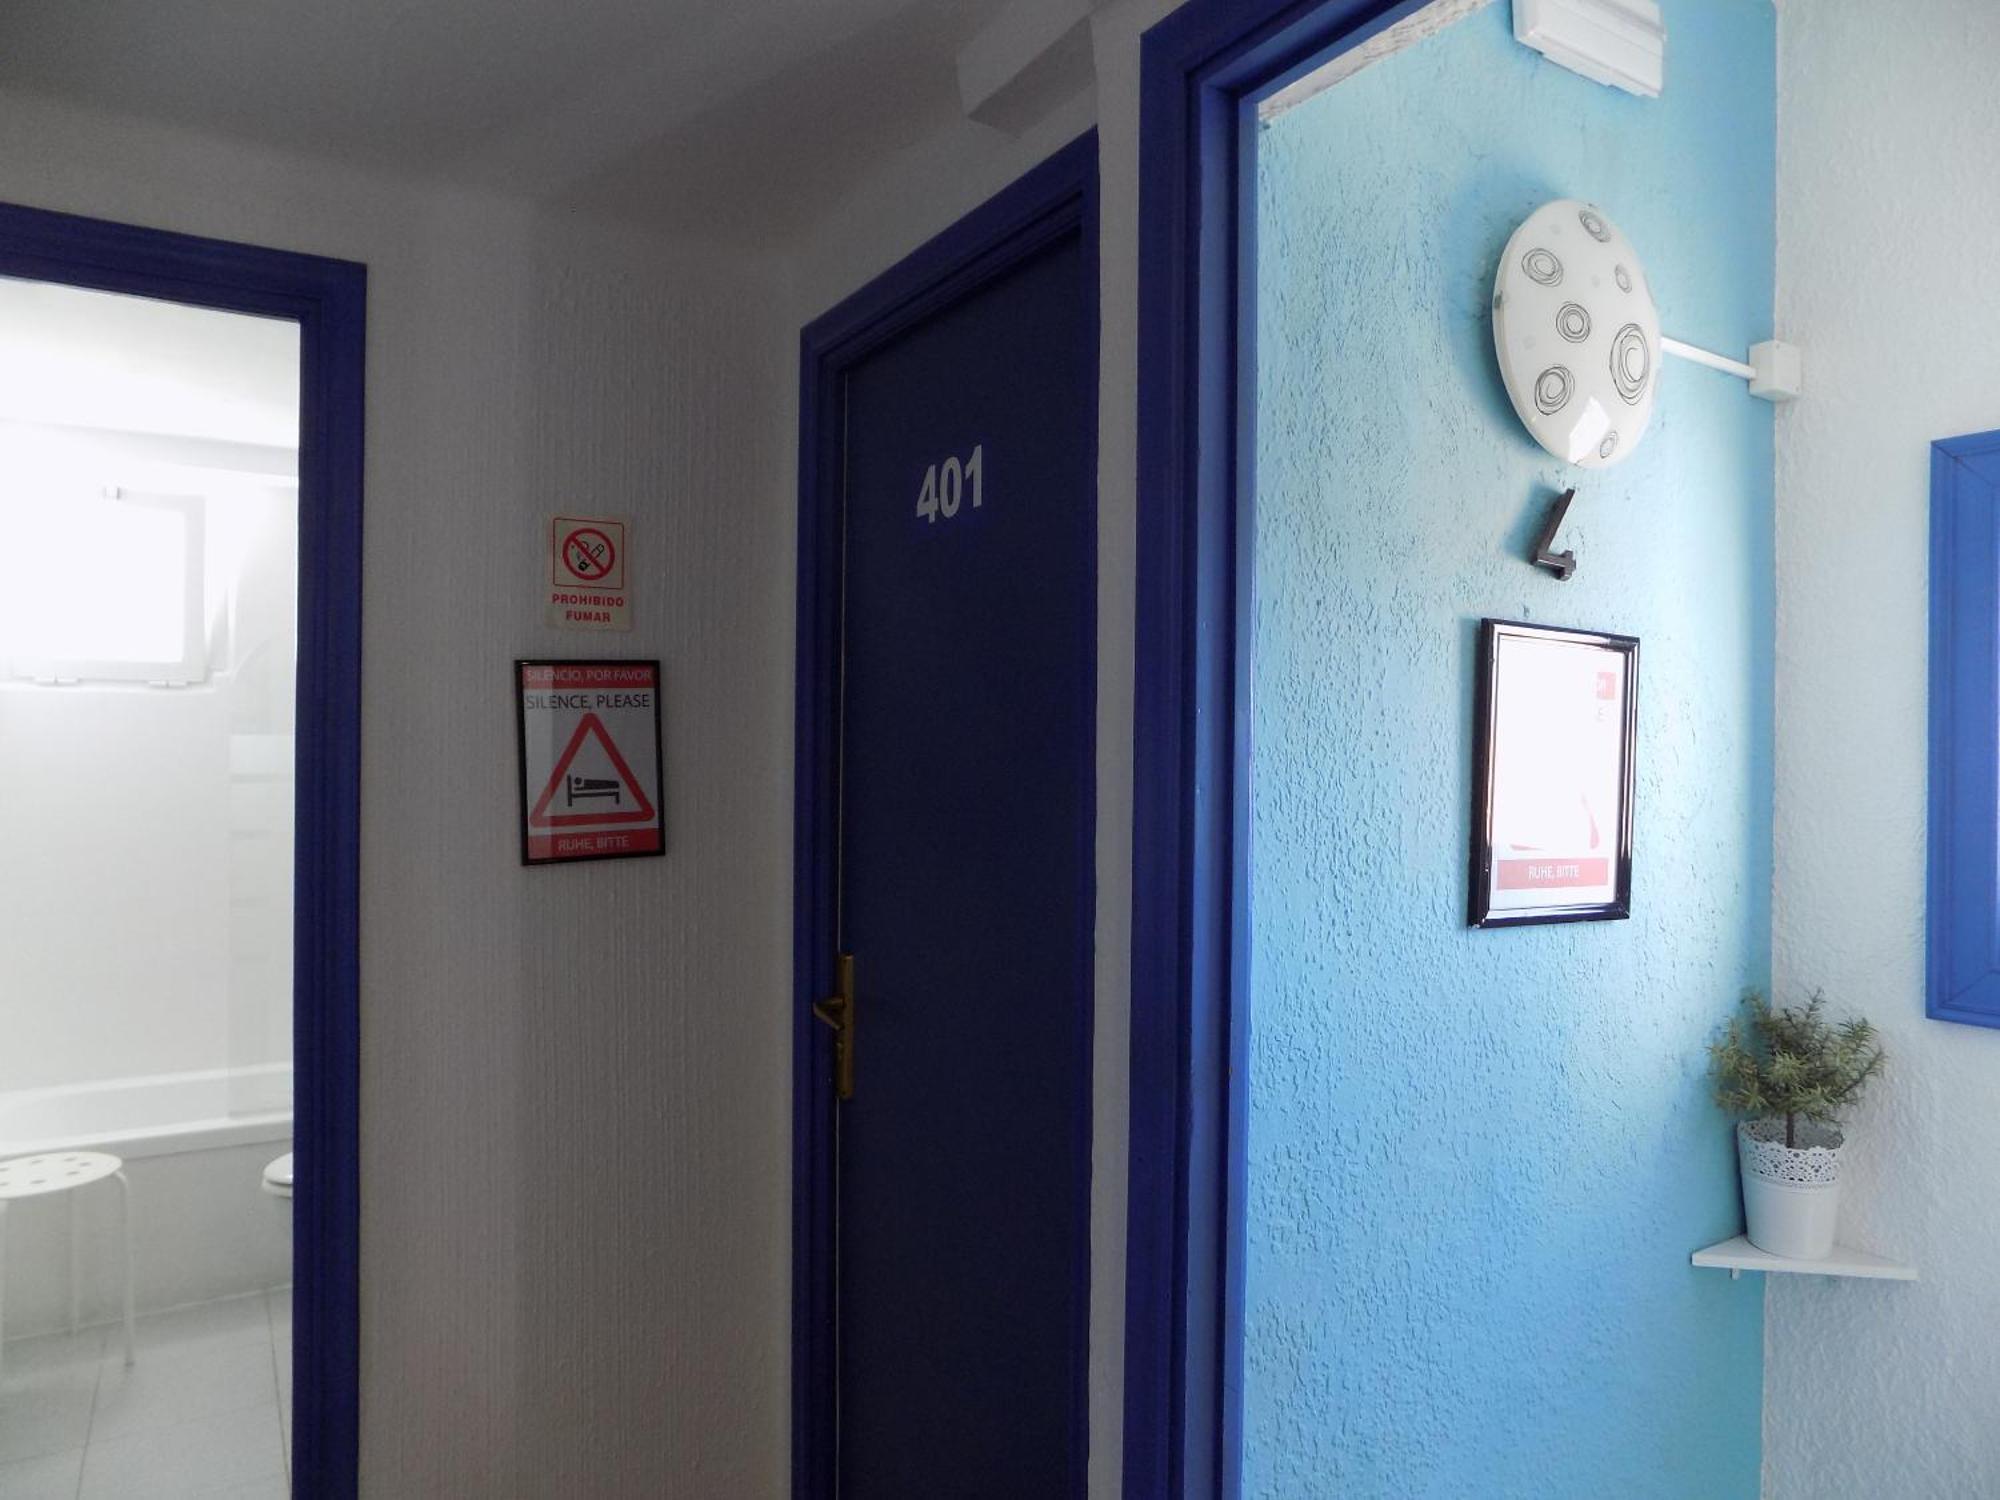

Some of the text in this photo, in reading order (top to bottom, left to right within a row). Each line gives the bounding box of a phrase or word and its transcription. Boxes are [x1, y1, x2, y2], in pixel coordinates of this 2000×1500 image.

[916, 444, 982, 523] 401
[551, 593, 624, 608] PROHIBIDO
[565, 610, 611, 622] FUMAR
[526, 670, 652, 682] SILENCIO, POR FAVOR
[525, 693, 650, 710] SILENCE, PLEASE
[558, 835, 630, 851] RUHE, BITTE
[1527, 864, 1580, 881] RUHE, BITTE
